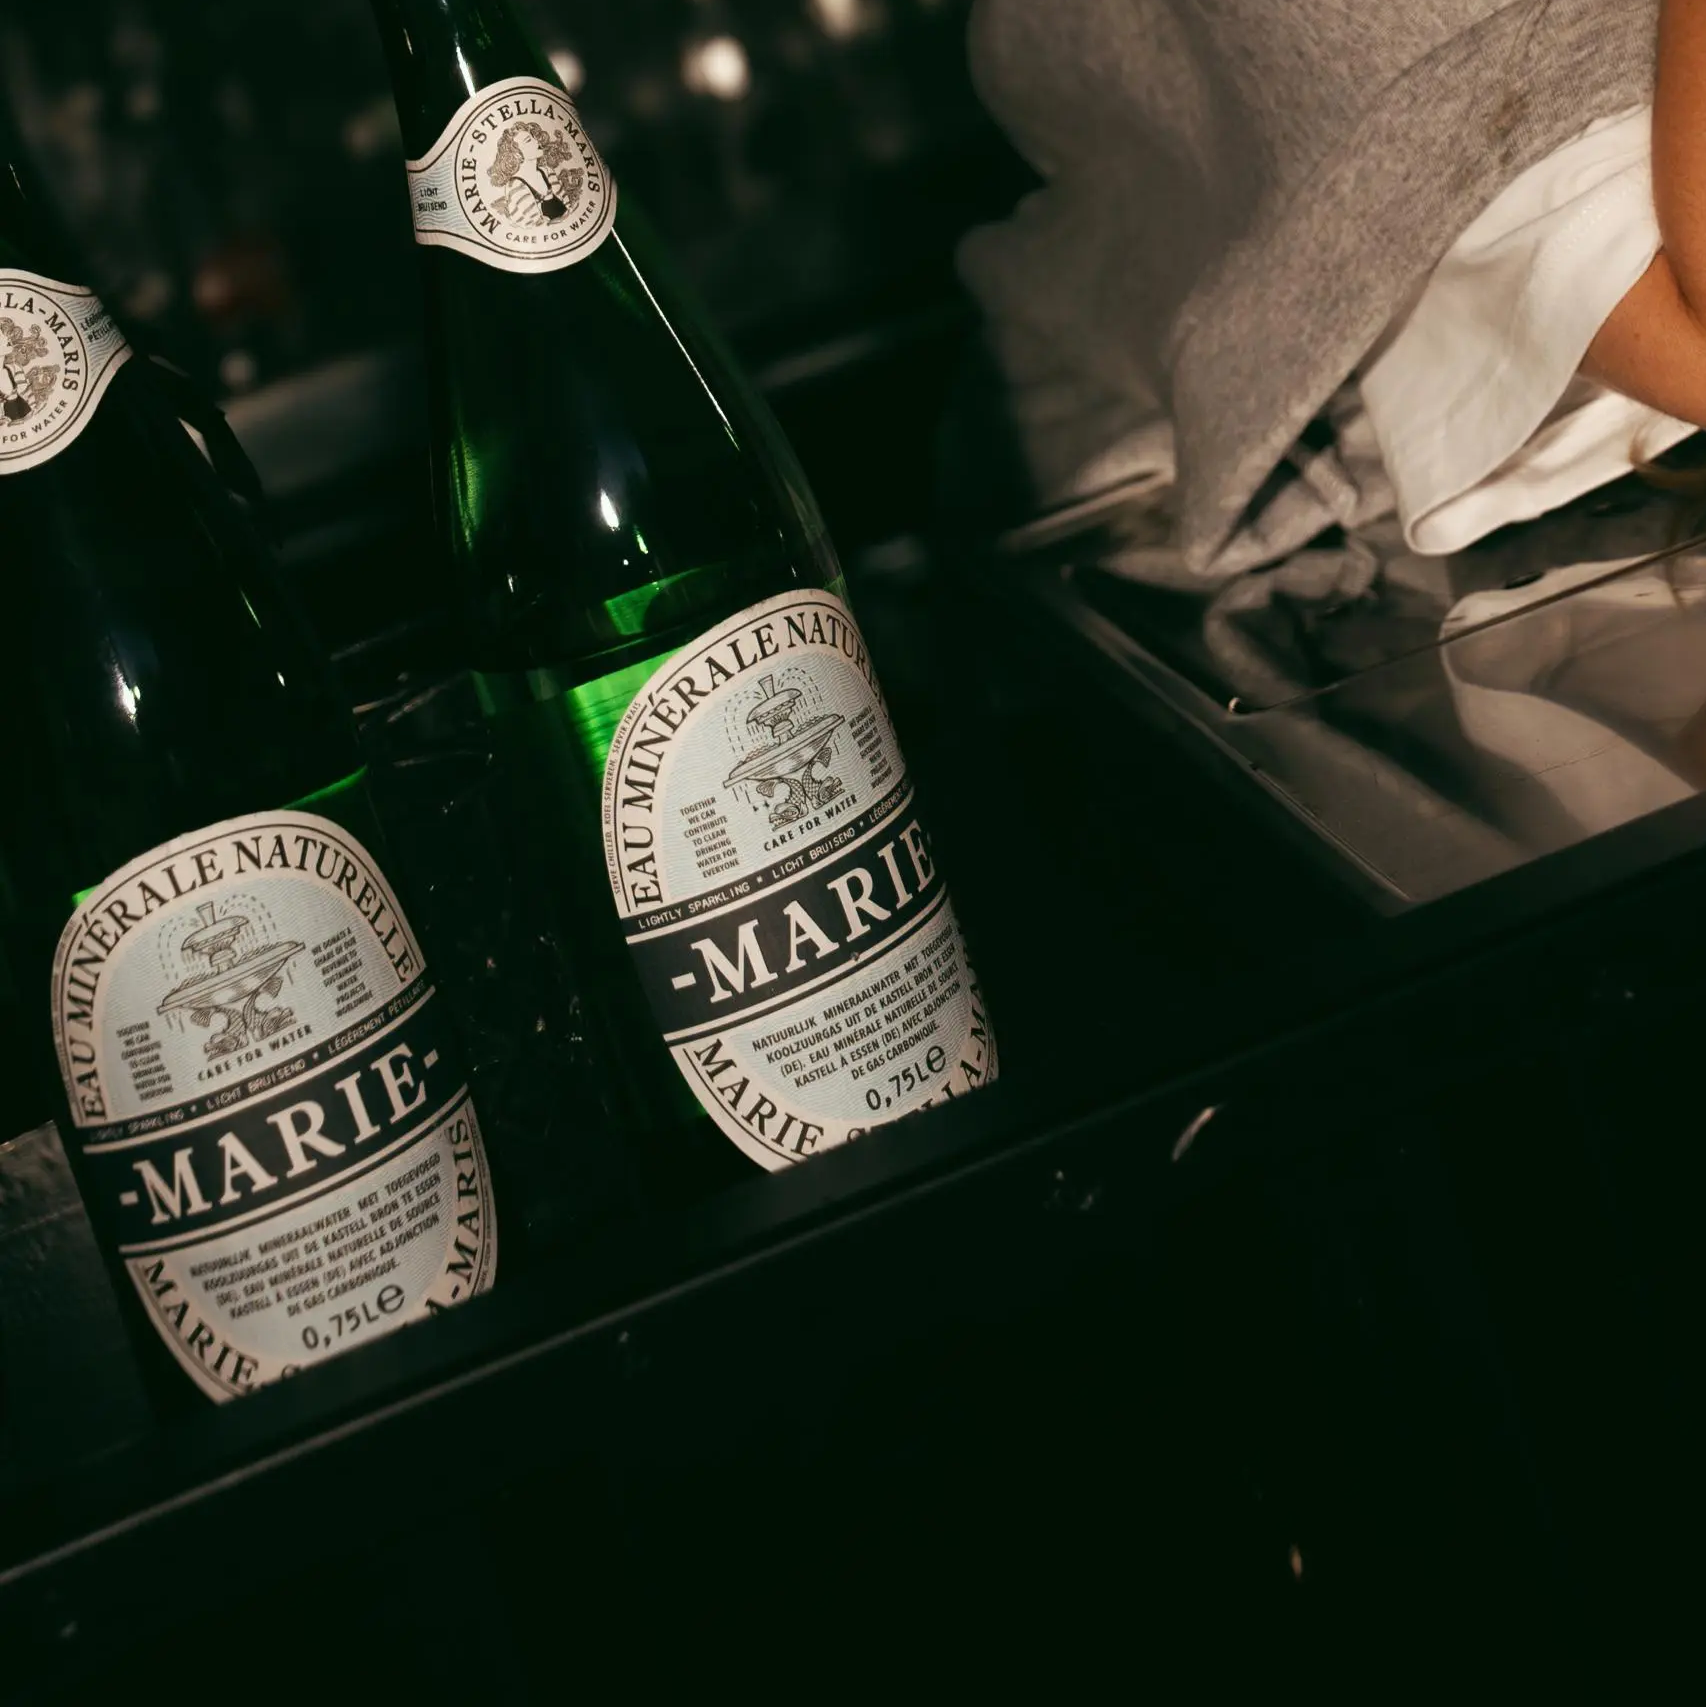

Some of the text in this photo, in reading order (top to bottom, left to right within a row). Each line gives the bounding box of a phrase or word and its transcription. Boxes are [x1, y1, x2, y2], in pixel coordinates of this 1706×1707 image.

[462, 99, 600, 234] MARIE-STELLA-MARIS
[506, 200, 597, 243] CARE FOR WATER
[2, 400, 67, 444] FOR WATER
[623, 623, 779, 813] MINÉRALE
[680, 797, 716, 816] TOGETHER
[683, 815, 728, 838] CONTRIBUTE
[688, 809, 716, 825] WE CAN
[693, 829, 726, 847] TO CLEAN
[763, 794, 857, 852] CARE FOR WATER
[623, 822, 663, 907] EAU
[638, 908, 682, 929] LIGHTLY
[688, 882, 751, 914] SPARKLING
[771, 856, 804, 879] LICHT
[808, 827, 856, 860] BRUISEND
[696, 838, 731, 858] DRINKING
[696, 849, 737, 870] WATER FOR
[702, 858, 740, 879] EVERYONE
[67, 849, 224, 1032] MINÉRALE
[231, 834, 414, 983] NATURELLE
[671, 818, 937, 1004] -MARIE
[752, 1016, 817, 1051] NATUURLIJK
[823, 971, 901, 1021] MINERAALWATER
[904, 956, 919, 975] MET
[766, 1024, 842, 1064] KOOLZUURGAS
[845, 1014, 861, 1031] UIT
[864, 1003, 878, 1018] DE
[880, 980, 914, 1012] KASTELL
[915, 966, 934, 986] BRON
[809, 1047, 830, 1064] EAU
[834, 1017, 882, 1053] MINÉRALE
[885, 989, 928, 1024] NATURELLE
[68, 1038, 105, 1120] EAU
[196, 1025, 313, 1081] CARE FOR WATER
[794, 1062, 840, 1088] KASTELL
[851, 1042, 879, 1064] ESSEN
[902, 1013, 923, 1036] AVEC
[851, 1066, 865, 1080] DE
[867, 1054, 886, 1073] GAS
